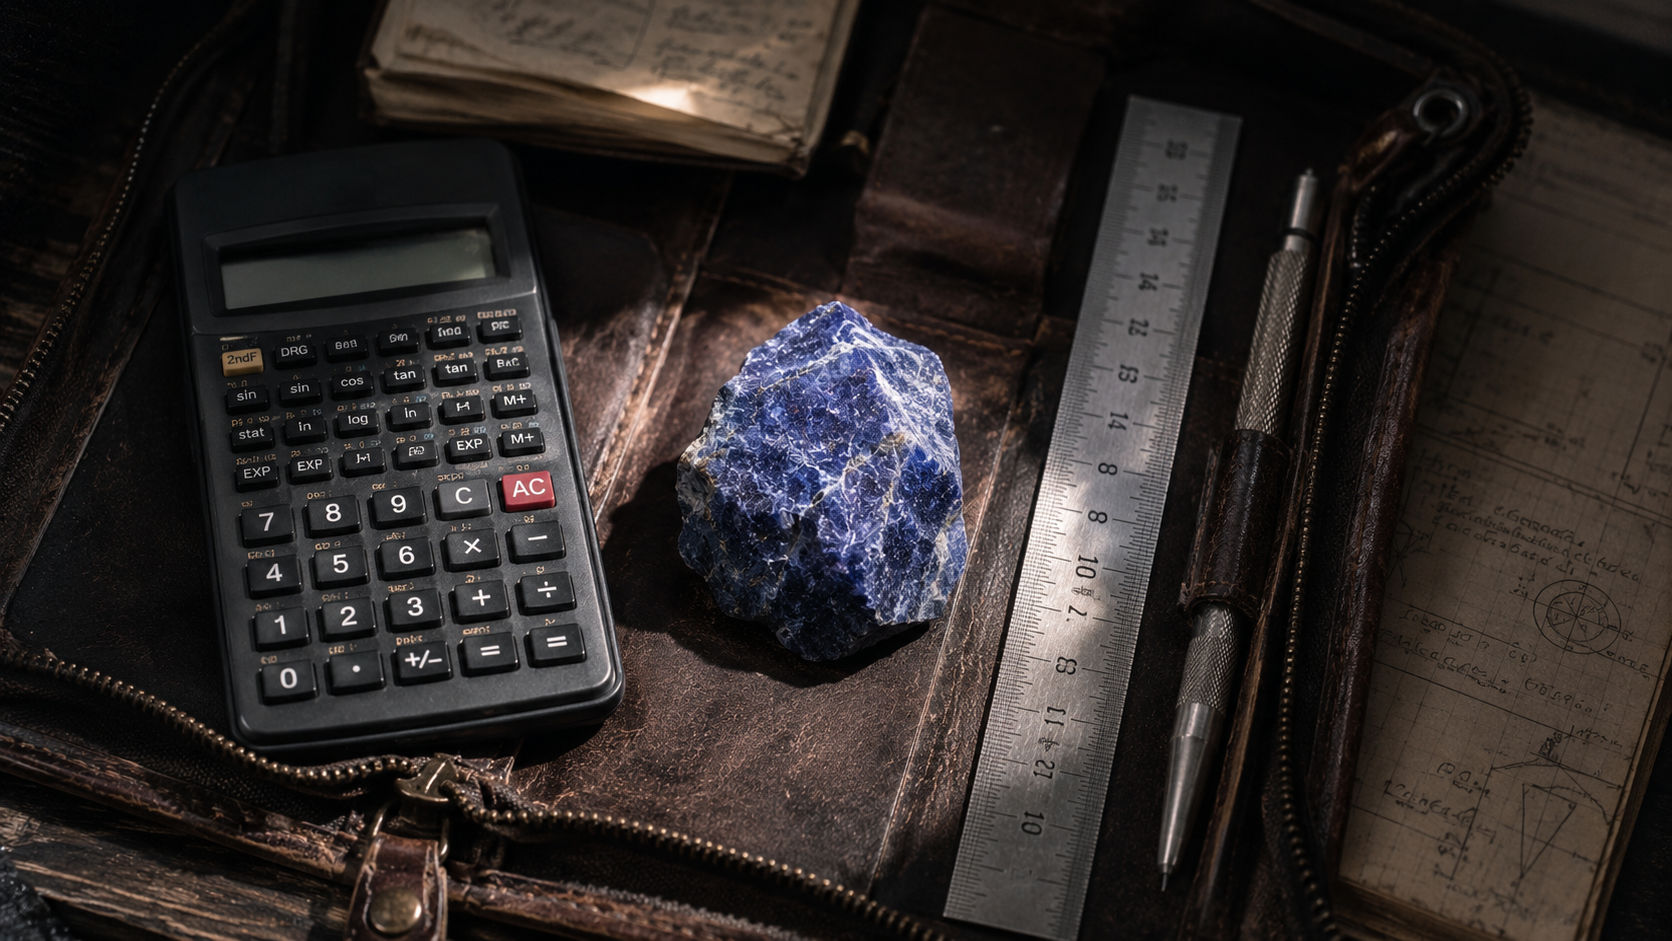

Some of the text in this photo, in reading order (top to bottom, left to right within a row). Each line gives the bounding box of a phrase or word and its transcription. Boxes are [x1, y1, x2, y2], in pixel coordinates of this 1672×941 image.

[281, 345, 308, 356] DRG
[227, 352, 256, 364] 2ndF
[394, 371, 416, 380] tan
[445, 365, 467, 373] tan
[291, 383, 309, 393] sin
[341, 378, 363, 386] cos
[237, 390, 256, 401] sin
[504, 395, 526, 405] M+
[348, 416, 368, 425] log
[1108, 412, 1128, 430] 14
[239, 428, 264, 439] stat
[511, 433, 534, 444] M+
[457, 439, 482, 450] EXP
[298, 459, 322, 471] EXP
[1098, 463, 1117, 475] 8
[244, 466, 270, 478] EXP
[511, 477, 547, 499] AC
[456, 487, 472, 504] C
[391, 496, 406, 513] 9
[326, 504, 341, 521] 8
[1088, 511, 1107, 524] 8
[259, 512, 273, 531] 7
[399, 546, 414, 564] 6
[334, 554, 348, 573] 5
[1076, 555, 1098, 579] 10
[266, 564, 282, 581] 4
[407, 597, 423, 616] 3
[341, 606, 357, 626] 2
[275, 616, 286, 634] 1
[280, 668, 297, 688] 0
[1021, 811, 1044, 835] 10
